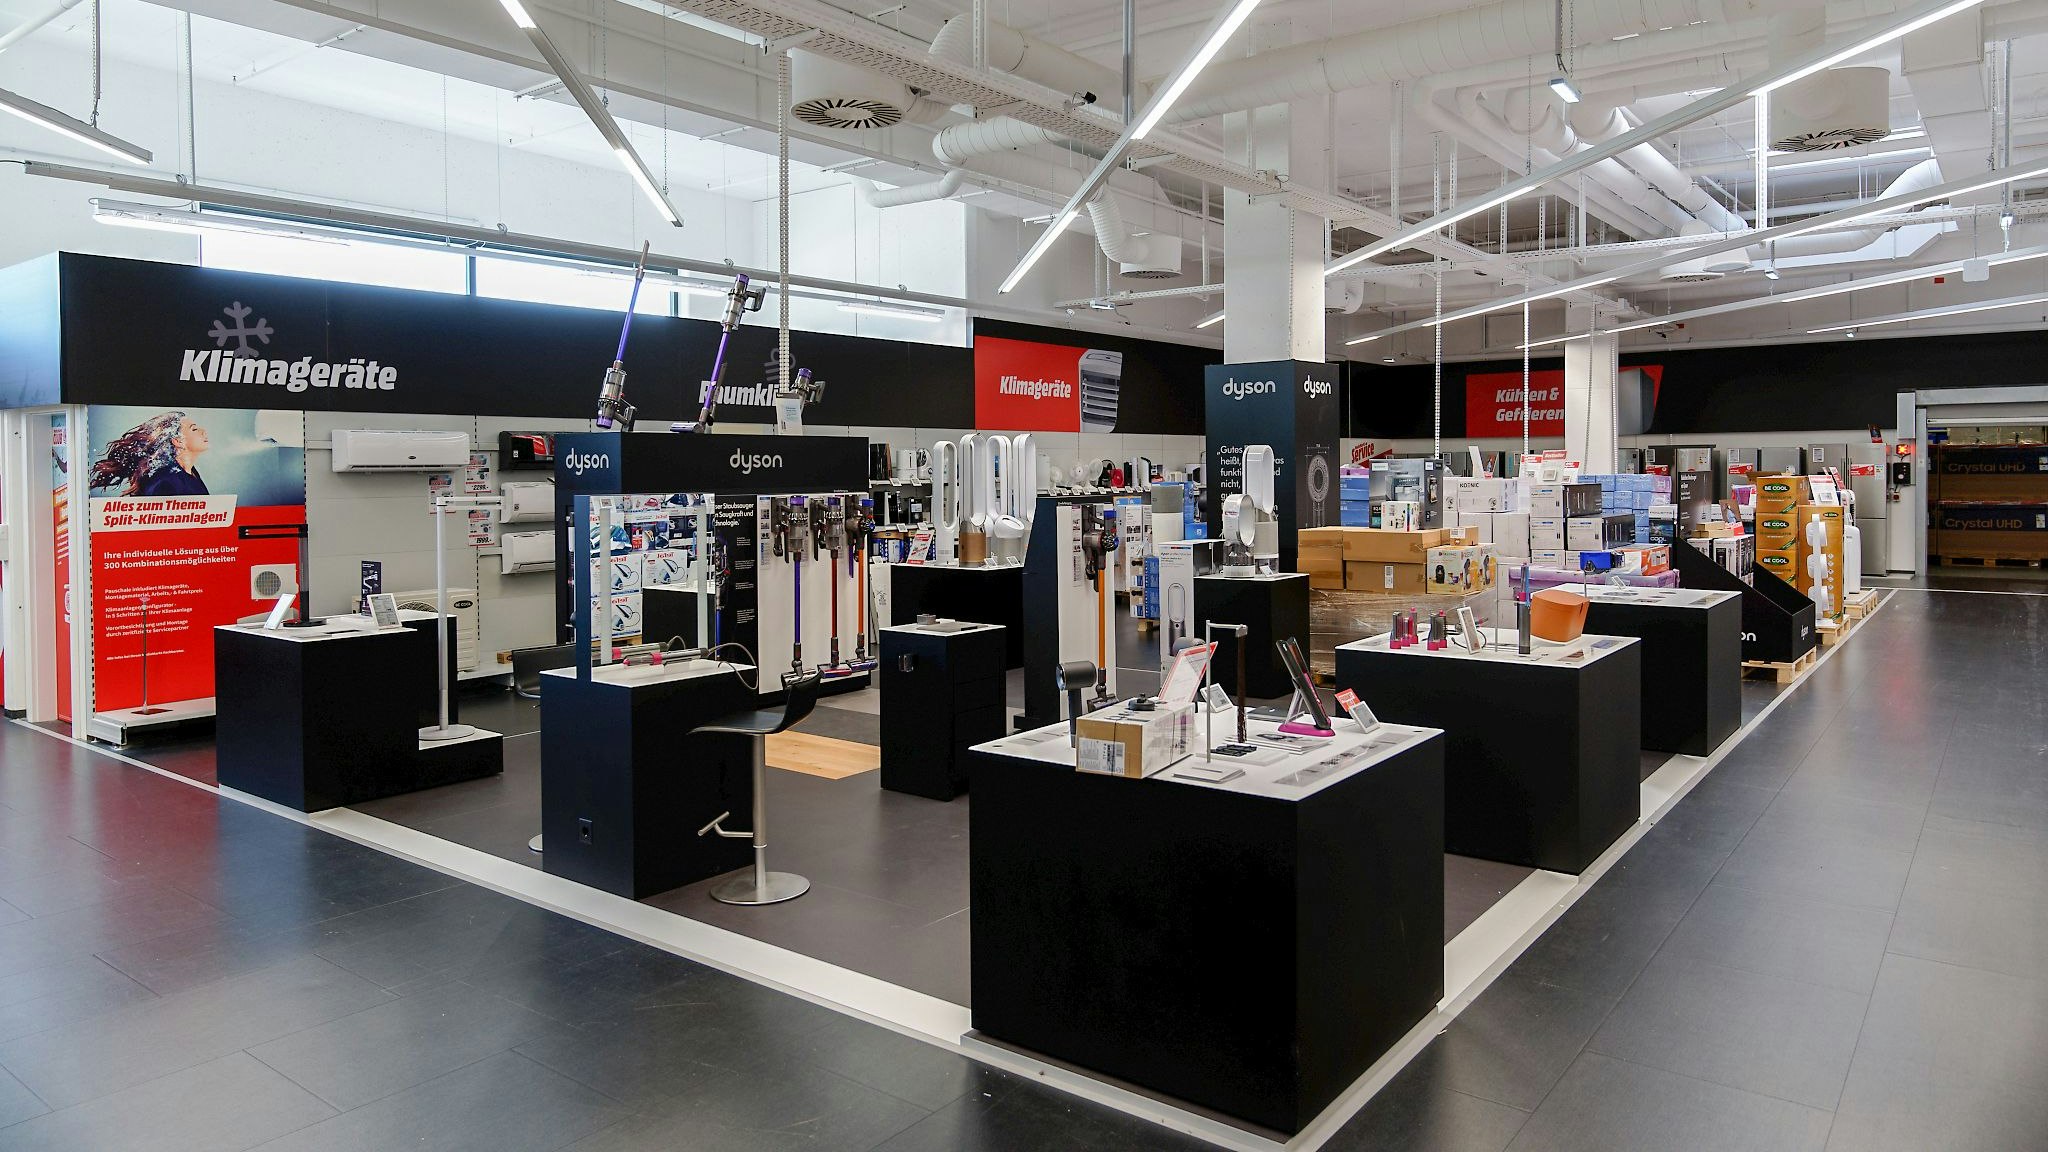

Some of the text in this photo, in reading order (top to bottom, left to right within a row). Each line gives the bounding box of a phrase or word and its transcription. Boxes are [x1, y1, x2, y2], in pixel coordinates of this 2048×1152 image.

[179, 349, 398, 393] Klimageräte
[999, 375, 1072, 400] Klimageräte
[1222, 377, 1276, 401] dyson
[1303, 374, 1332, 399] dyson
[1495, 387, 1559, 403] Kühen &
[728, 447, 783, 475] dyson
[1351, 442, 1375, 464] Service
[565, 447, 610, 476] dyson
[1948, 463, 2026, 474] Crystal UHD
[1220, 479, 1241, 489] nicht,
[103, 499, 207, 513] Alles zum Thema
[103, 511, 228, 528] Split-Klimaanlagen!
[1945, 518, 2023, 530] Crystal UHD
[103, 551, 121, 560] Ihre
[123, 549, 173, 559] individuelle
[174, 547, 204, 558] Lösung
[220, 546, 239, 554] über
[104, 555, 236, 570] 300 Kombinationsmöglichkeiten
[105, 602, 174, 613] Klimaanlagenonfigurator
